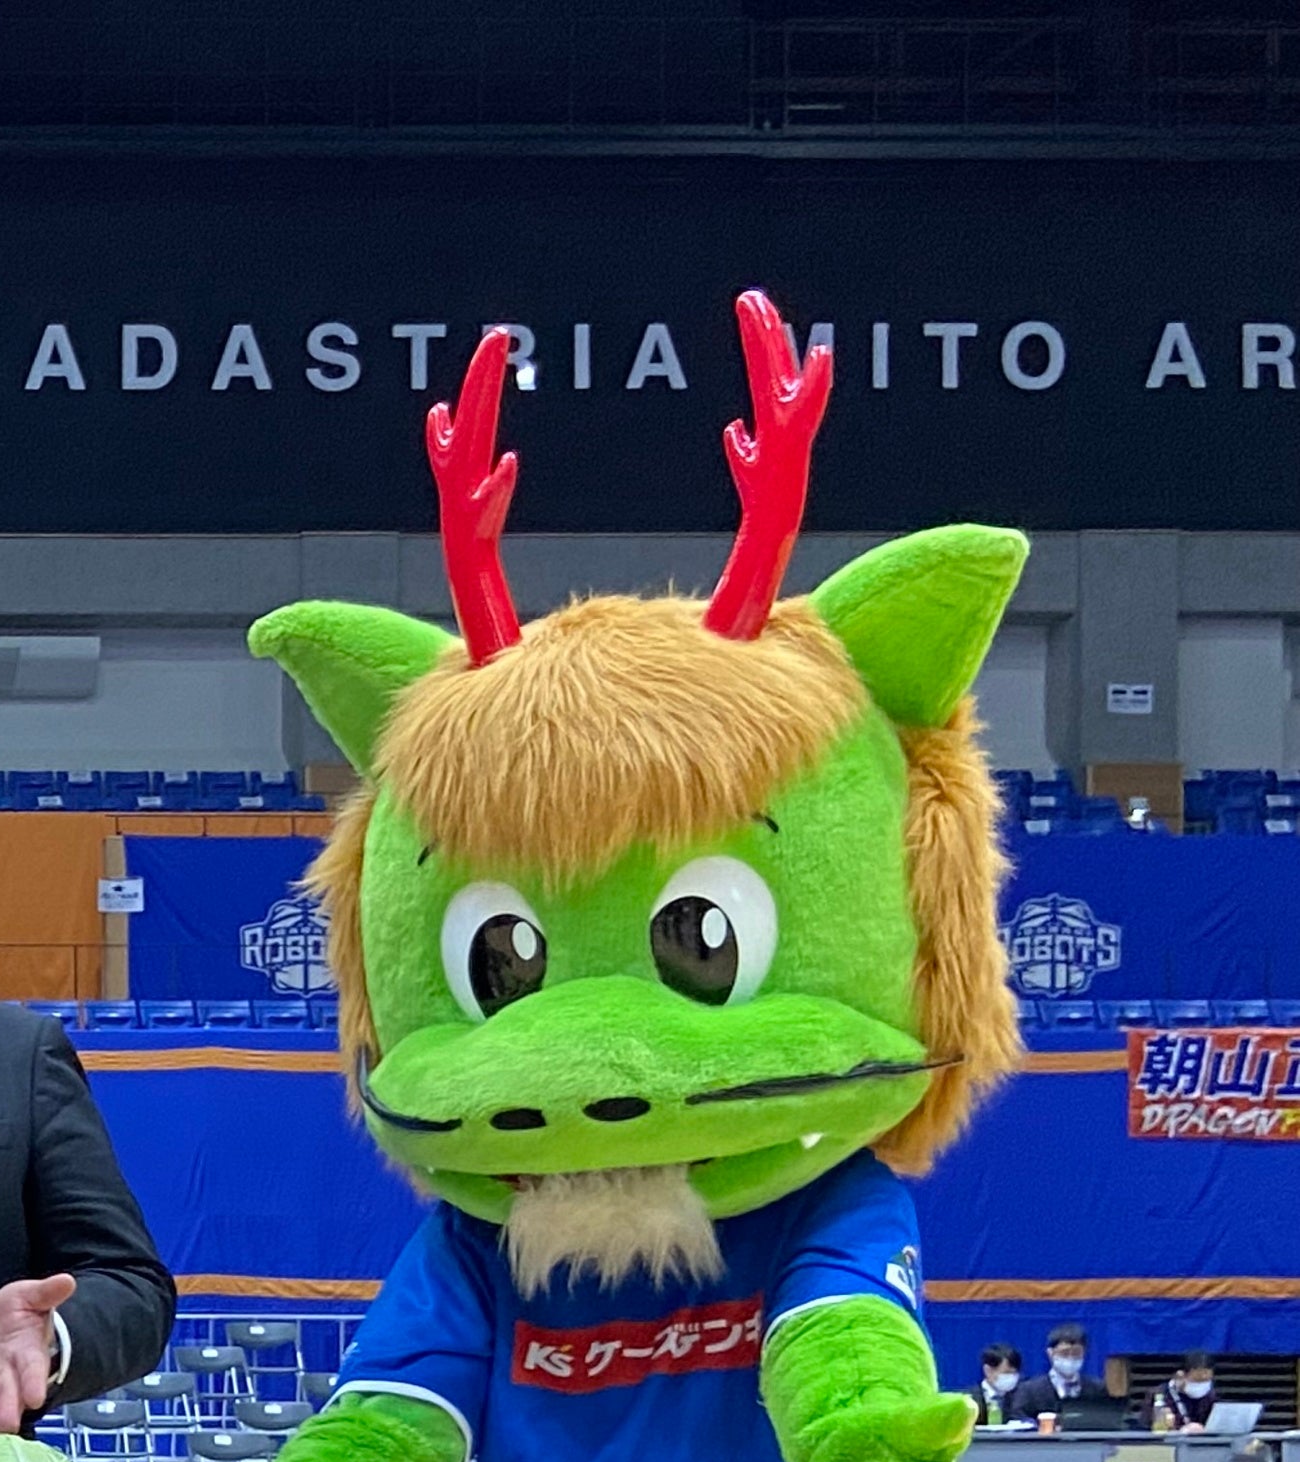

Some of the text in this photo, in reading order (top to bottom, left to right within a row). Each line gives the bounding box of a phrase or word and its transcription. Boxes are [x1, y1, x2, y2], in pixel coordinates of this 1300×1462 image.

[25, 322, 1298, 391] ADASTRIA ITO AR
[243, 927, 330, 968] ROBO
